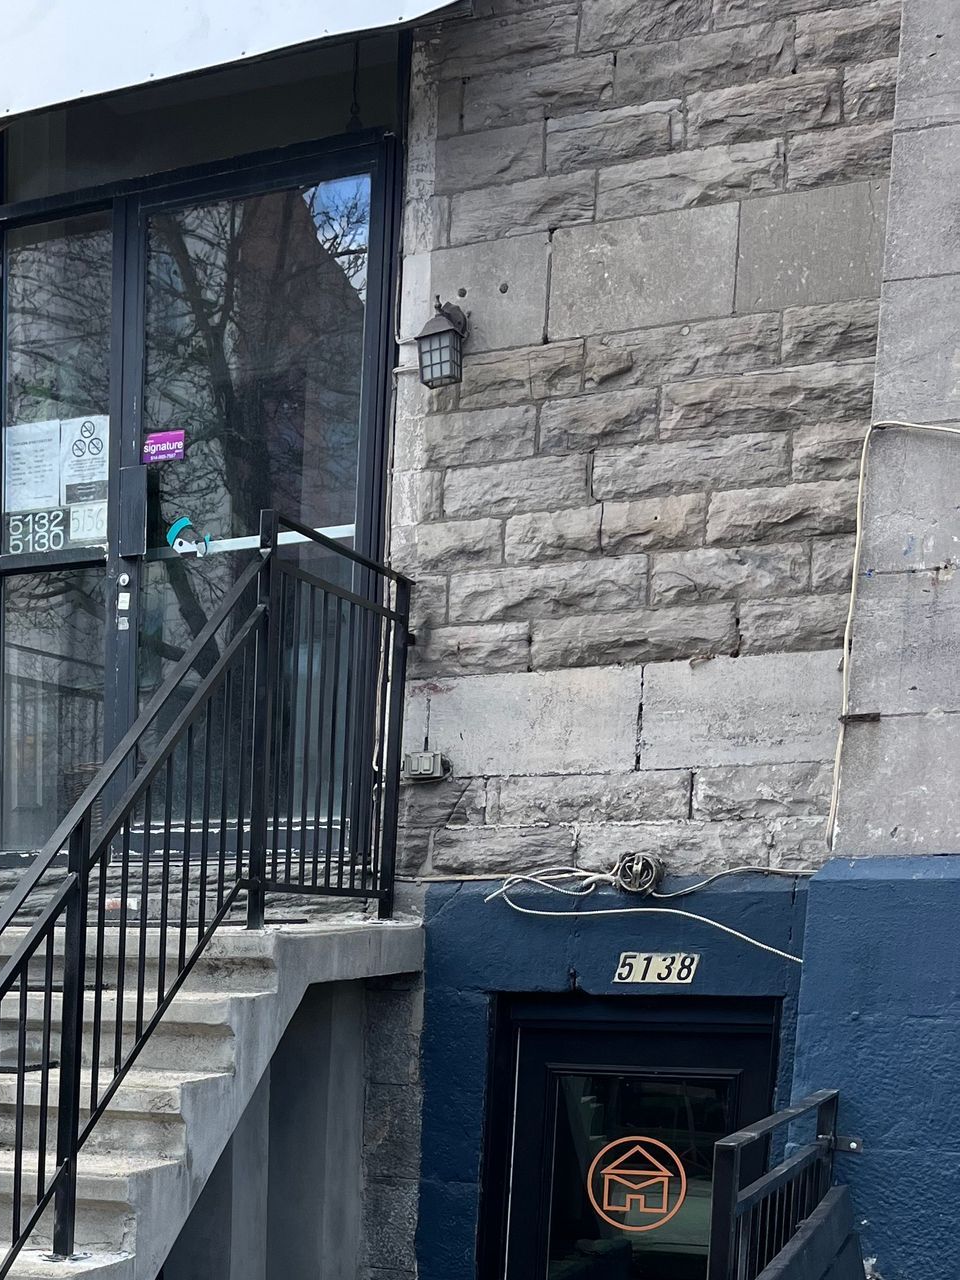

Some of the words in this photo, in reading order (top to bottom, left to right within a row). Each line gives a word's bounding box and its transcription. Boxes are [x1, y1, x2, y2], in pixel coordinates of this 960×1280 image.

[143, 441, 184, 454] signature
[9, 511, 64, 535] 5132
[9, 530, 64, 553] 5130
[617, 954, 696, 981] 5138
